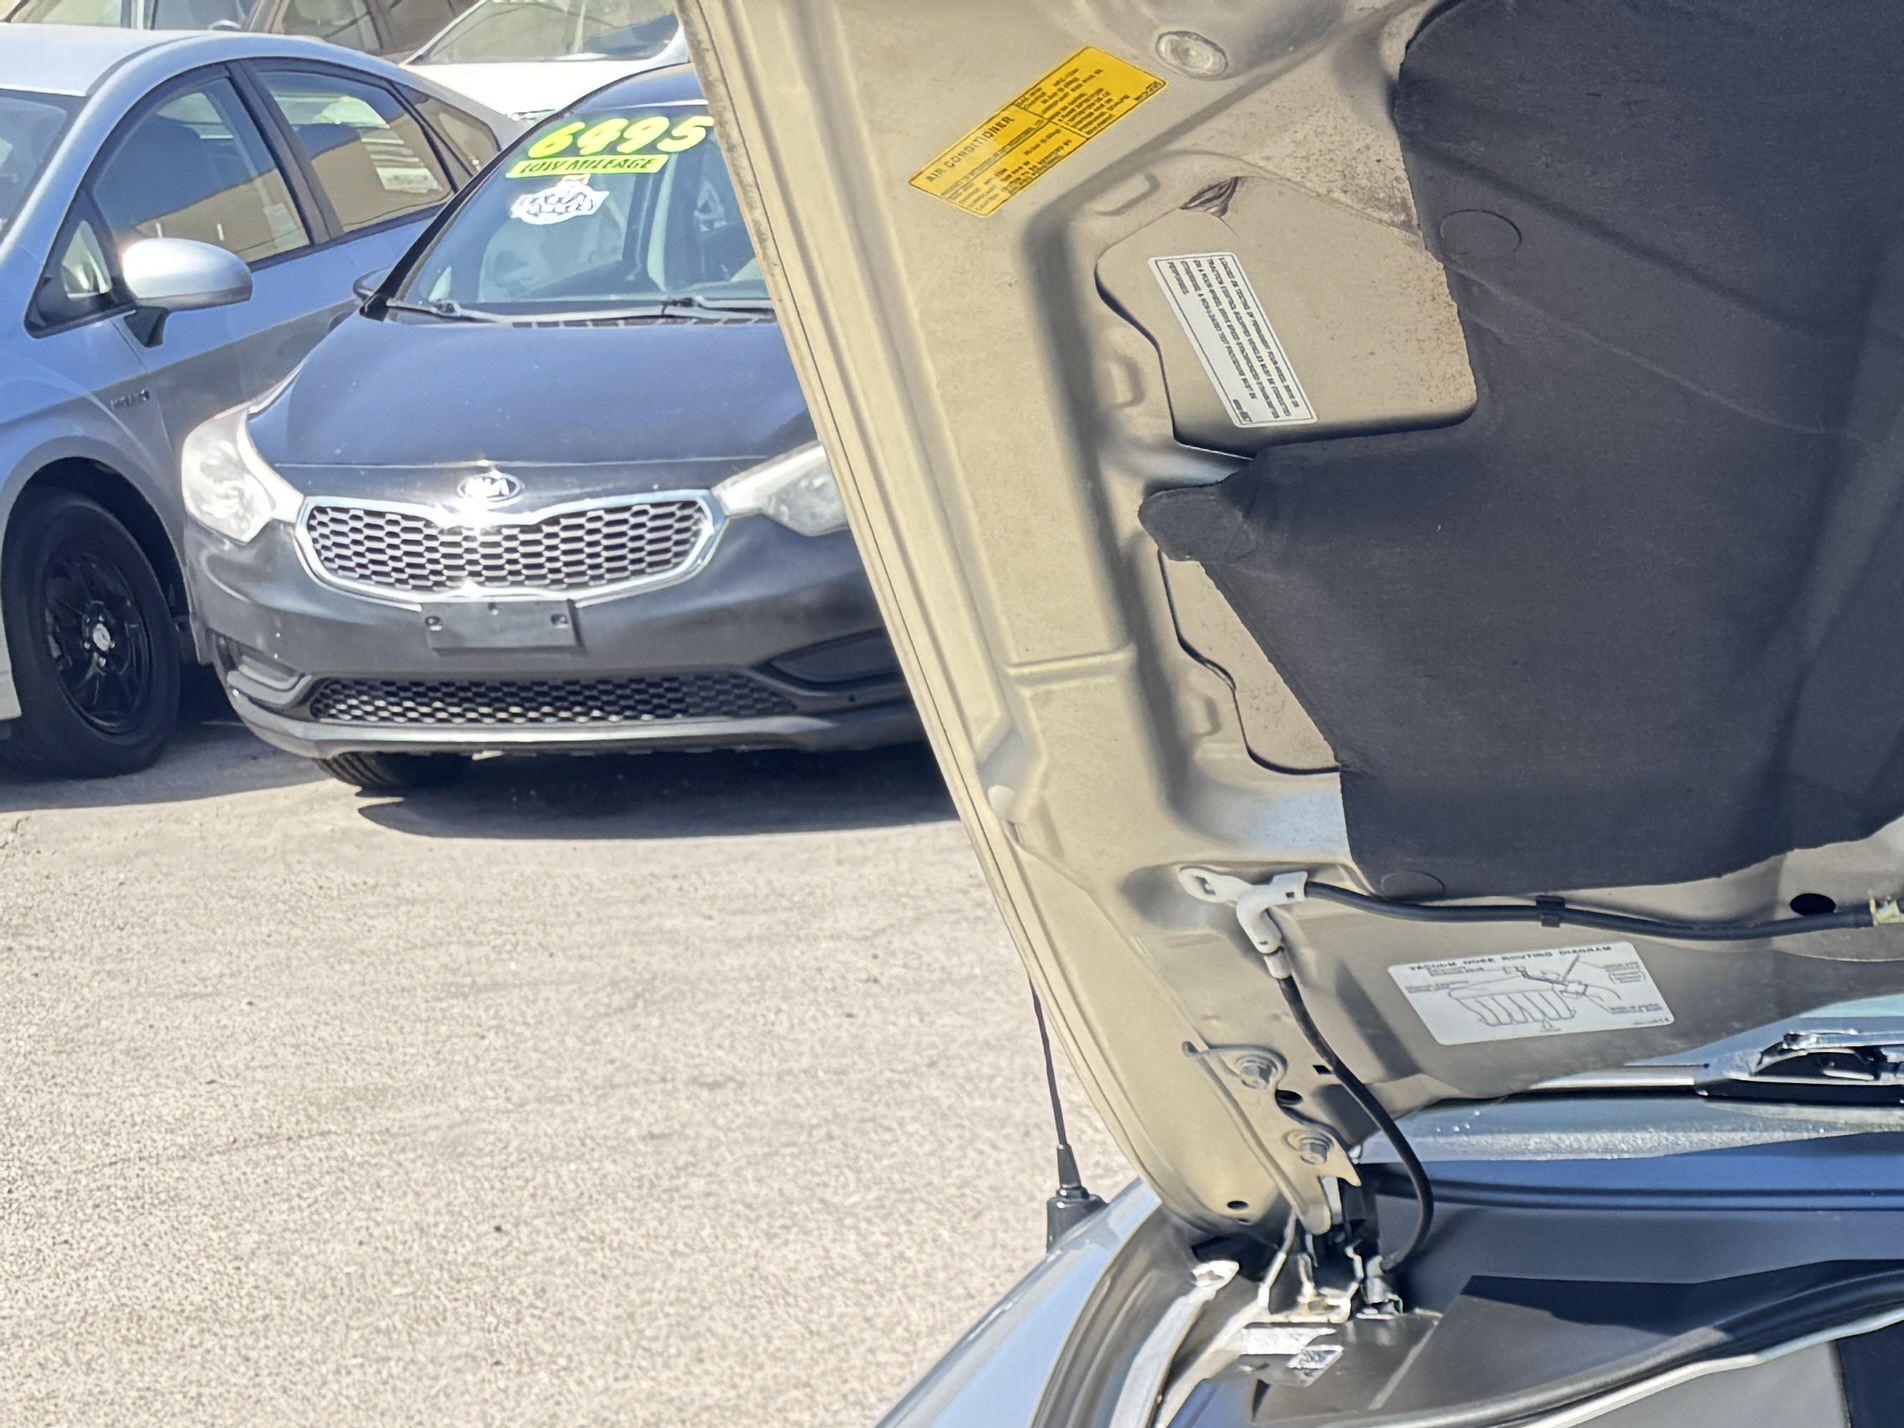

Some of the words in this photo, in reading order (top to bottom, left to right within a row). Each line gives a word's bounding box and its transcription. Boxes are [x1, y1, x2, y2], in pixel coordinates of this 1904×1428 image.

[925, 165, 946, 182] AIR
[942, 113, 1014, 169] CONDITIONER
[565, 157, 655, 171] MILEAGE
[1409, 962, 1457, 971] VACUUM
[1463, 957, 1496, 965] HOSE
[1501, 952, 1553, 961] ROUTING
[1559, 946, 1612, 955] DIAGRAM
